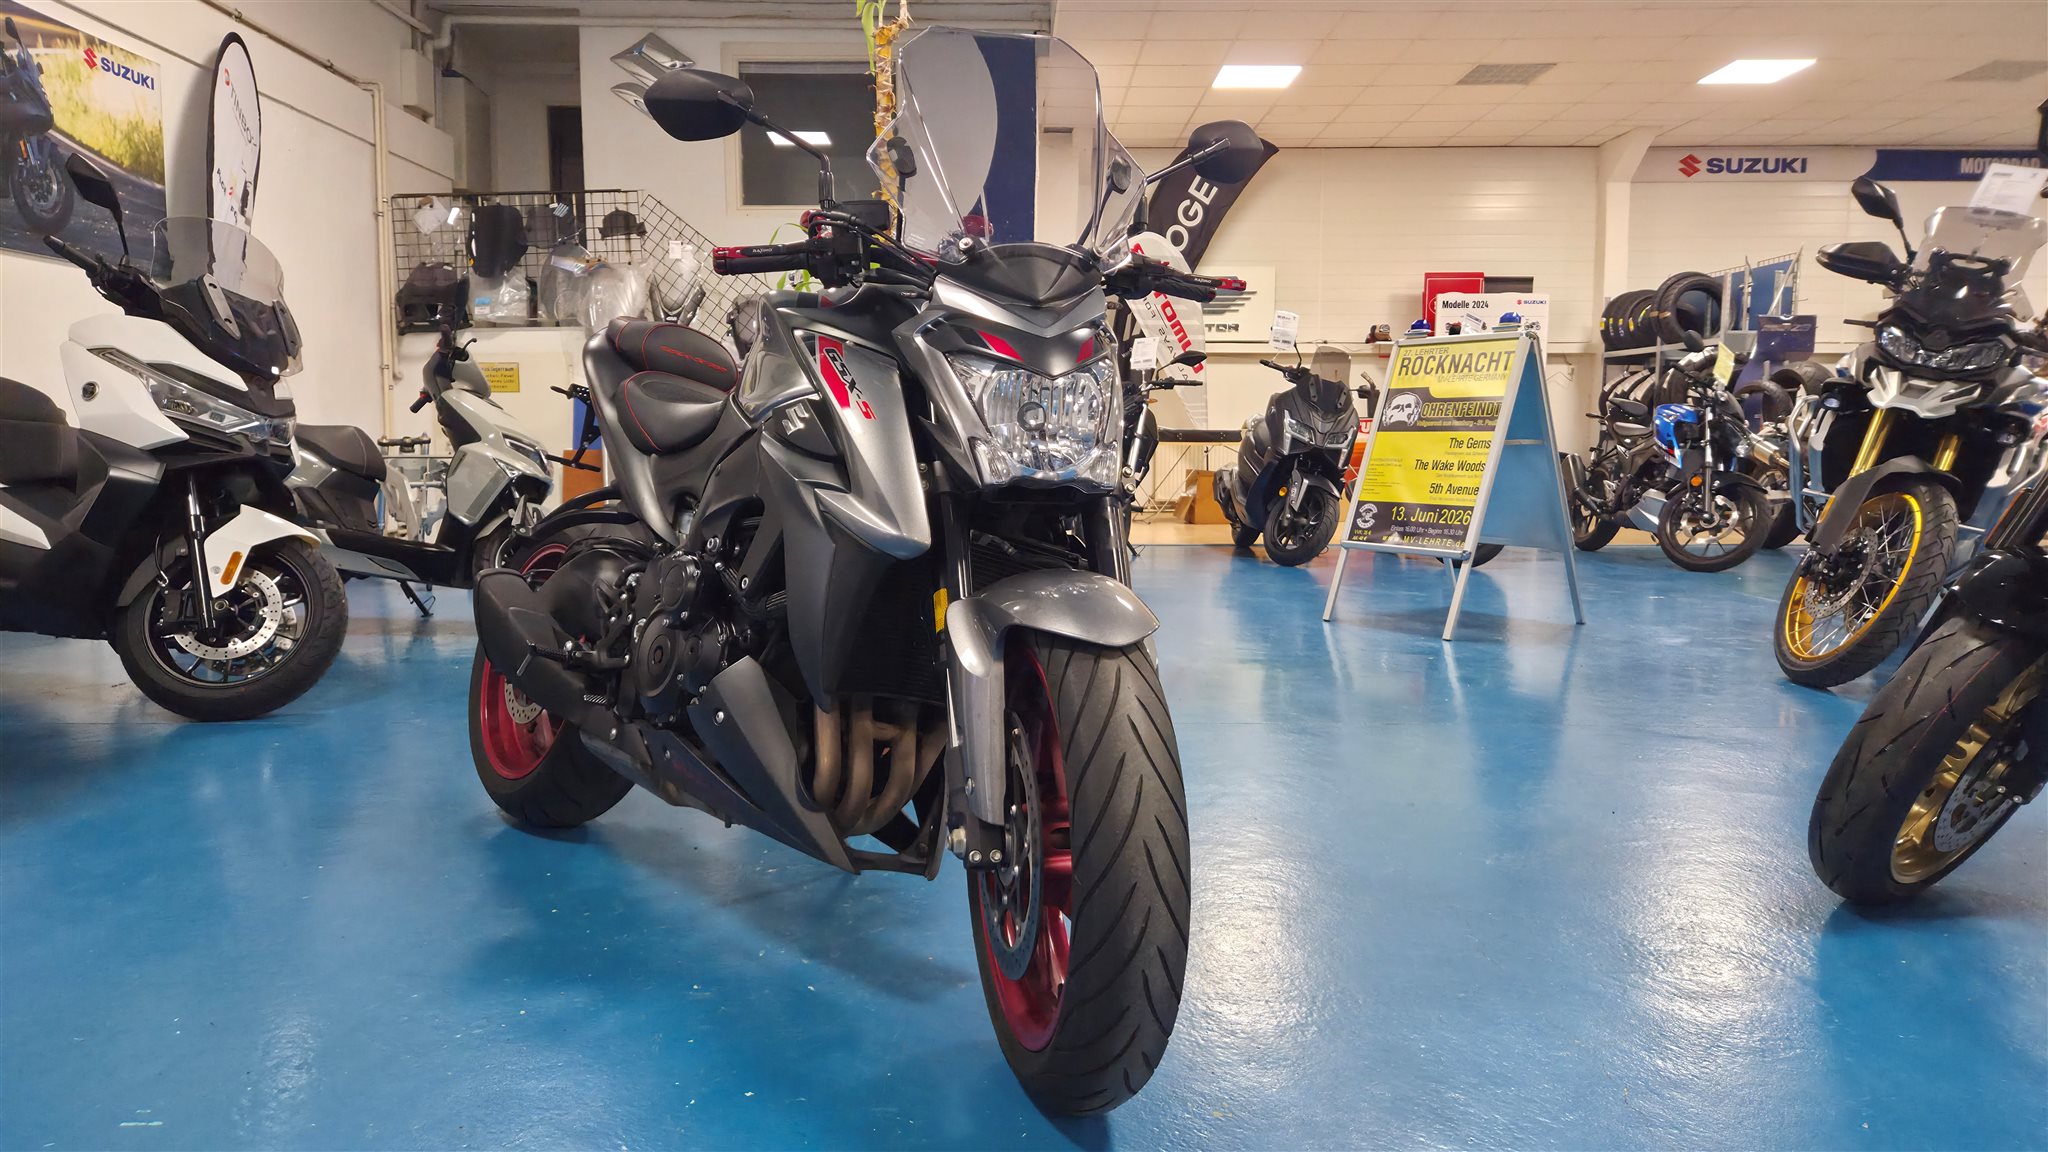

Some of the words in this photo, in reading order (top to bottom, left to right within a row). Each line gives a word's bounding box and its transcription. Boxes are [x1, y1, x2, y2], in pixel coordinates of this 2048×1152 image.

[100, 56, 154, 91] SUZUKI
[1706, 157, 1808, 174] SUZUKI
[1165, 175, 1219, 251] OGE
[1442, 300, 1470, 309] Modelle
[1472, 300, 1489, 309] 2024
[1415, 346, 1450, 355] LEHRTER
[1397, 350, 1516, 377] ROCKNACHT
[1421, 401, 1503, 418] OHRENFEINDT
[1449, 437, 1464, 449] The
[1466, 437, 1492, 449] Gems
[1414, 459, 1429, 471] The
[1431, 460, 1455, 471] Wake
[1456, 460, 1486, 472] Woods
[1429, 482, 1444, 494] 5th
[1445, 483, 1480, 495] Avenue
[1391, 506, 1407, 521] 13.
[1410, 507, 1440, 523] Juni
[1439, 508, 1472, 525] 2026
